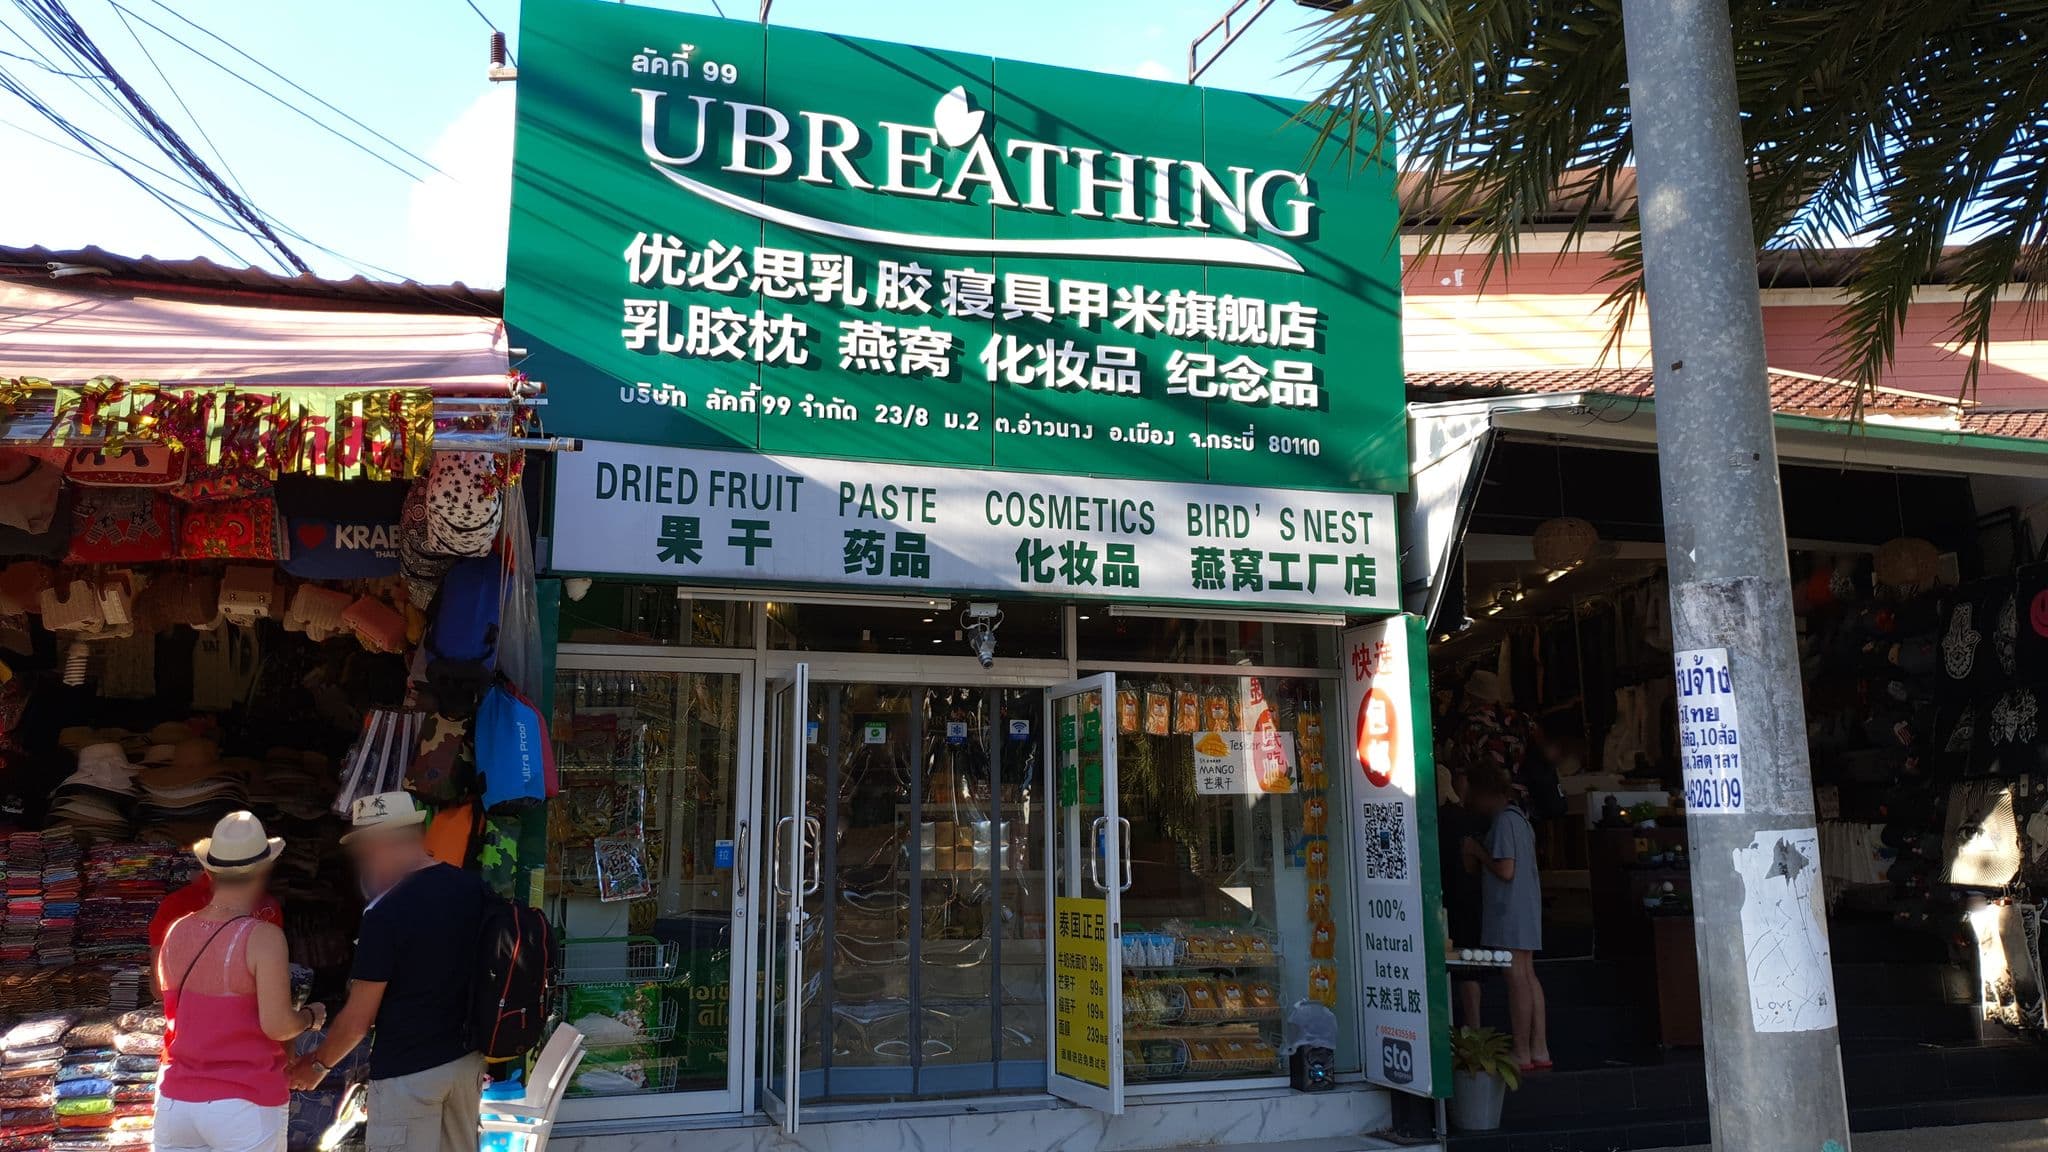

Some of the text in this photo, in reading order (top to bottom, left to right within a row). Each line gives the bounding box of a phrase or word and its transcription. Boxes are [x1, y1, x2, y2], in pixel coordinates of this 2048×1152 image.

[632, 43, 738, 85] ลัคกี้ 99
[631, 87, 1316, 238] UBREATHING
[623, 231, 1318, 350] 优必思乳胶寝具甲米旗舰店
[621, 298, 1319, 408] 乳胶枕 燕窝 化妆品 纪念品
[619, 381, 688, 409] บริษัท
[798, 393, 858, 422] จำกัด
[875, 403, 929, 428] 23/8
[944, 410, 980, 432] ม.2
[994, 412, 1094, 440] ต.อ่าวนาง
[1109, 421, 1176, 447] อ.เมือง
[1188, 423, 1256, 452] จ.กระบี่
[1268, 435, 1321, 457] 80110
[595, 461, 699, 506] DRIED
[708, 469, 805, 513] FRUIT
[838, 480, 937, 524] PASTE
[985, 489, 1156, 536] COSMETICS
[1303, 508, 1374, 546] NEST
[335, 524, 401, 550] KRAB
[843, 528, 931, 580] 药品
[1015, 537, 1141, 589] 化妆品
[1190, 545, 1378, 598] 燕窝工厂店
[1229, 738, 1263, 751] Teser
[1199, 764, 1235, 775] MANGO
[1058, 909, 1106, 943] 泰国正品
[1367, 898, 1406, 922] 100%
[1365, 931, 1414, 953] Natural
[1374, 959, 1410, 981] latex
[1365, 985, 1422, 1014] 天然乳胶
[1383, 1042, 1412, 1072] sto
